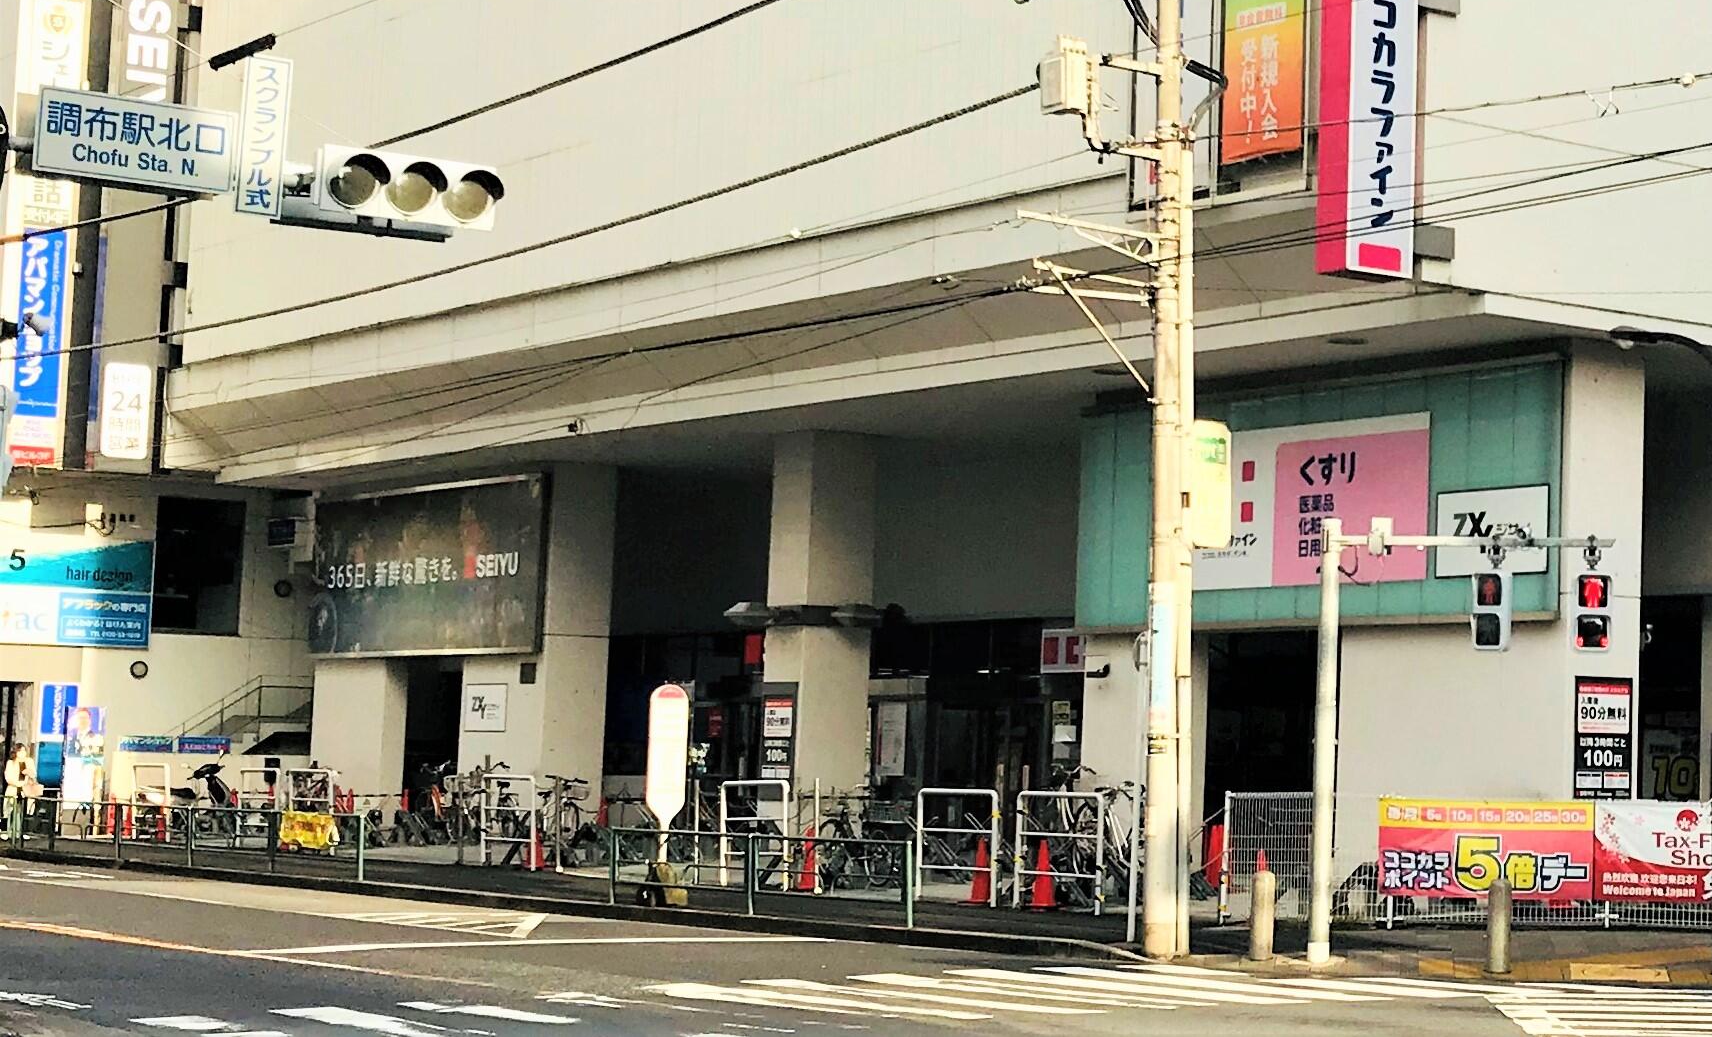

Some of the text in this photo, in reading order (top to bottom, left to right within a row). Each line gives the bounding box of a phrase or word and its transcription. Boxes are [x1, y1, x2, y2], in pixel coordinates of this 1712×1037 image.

[1260, 34, 1280, 141] 新規入会
[46, 100, 226, 156] 調布駅北口
[72, 143, 200, 177] Chofu Sta. N.
[18, 237, 49, 387] アパマンョップ
[111, 390, 143, 412] 24
[1299, 450, 1357, 486] くすり
[1298, 493, 1335, 514] 医薬品
[1298, 516, 1332, 536] 化粧
[9, 548, 26, 572] 5
[475, 551, 520, 579] SEIYU
[66, 565, 92, 581] hair
[1580, 706, 1627, 720] 90分無料
[1583, 749, 1623, 767] 100円
[1383, 851, 1450, 871] ココカラ
[1384, 869, 1450, 888] ポイント
[1602, 884, 1651, 897] Welcome
[1665, 886, 1696, 899] Japan
